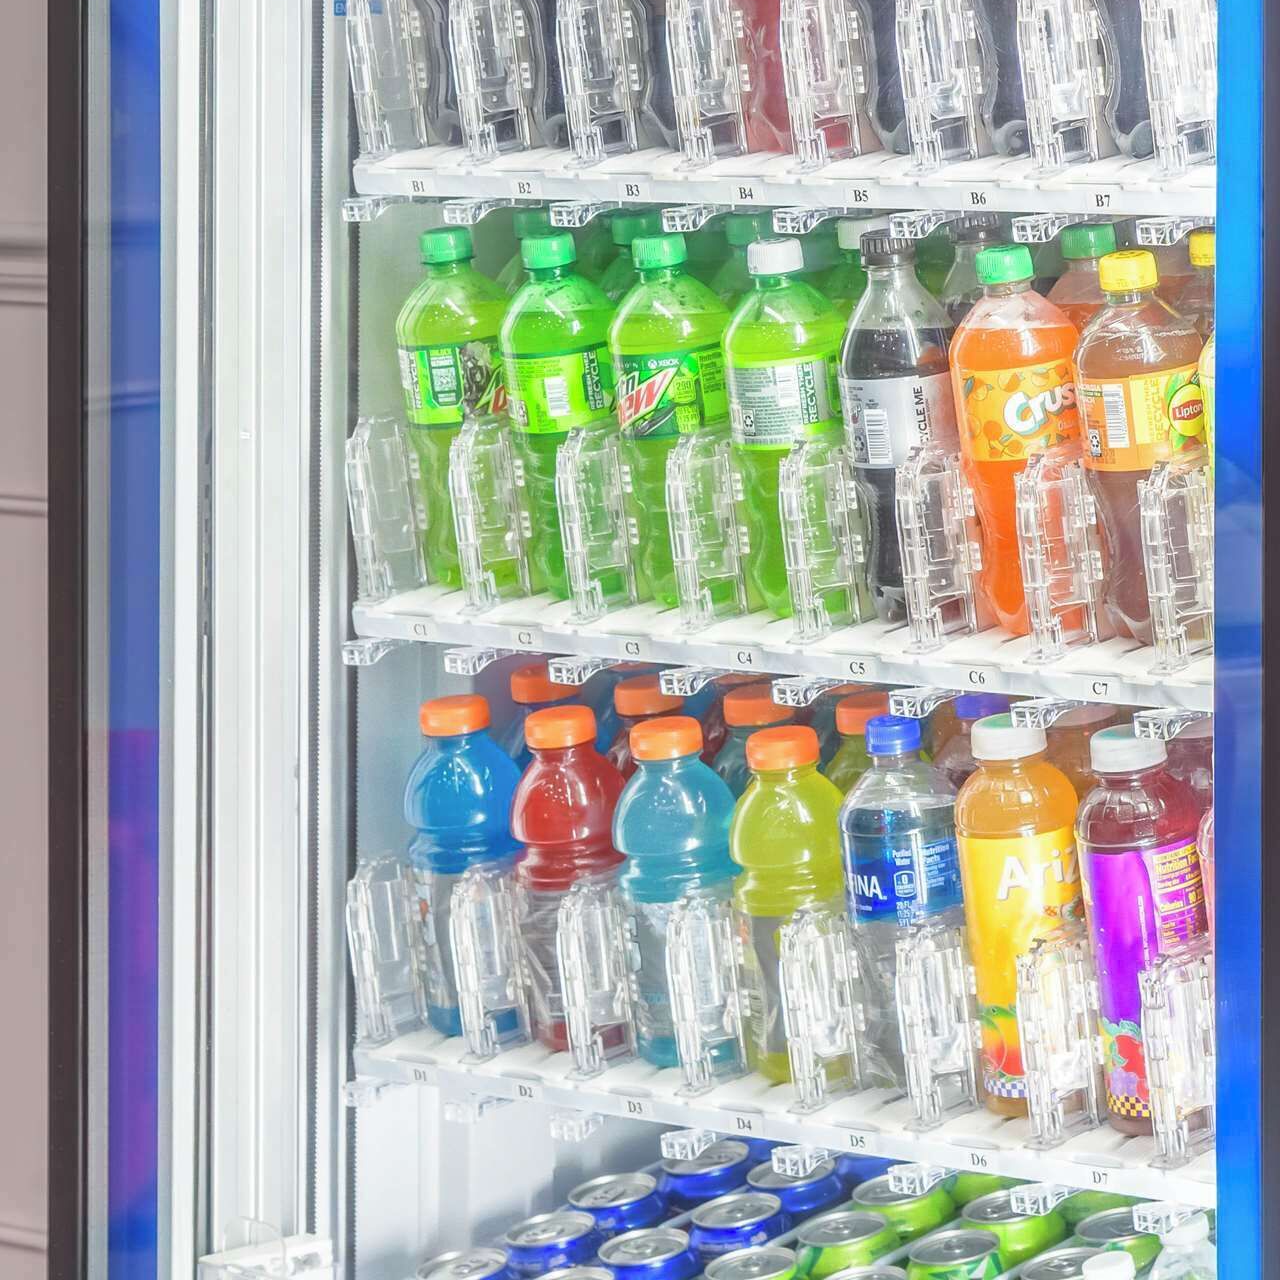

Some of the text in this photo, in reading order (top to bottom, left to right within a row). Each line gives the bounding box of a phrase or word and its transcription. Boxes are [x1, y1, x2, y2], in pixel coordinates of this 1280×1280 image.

[412, 180, 426, 193] B1
[625, 183, 640, 196] B3
[970, 192, 987, 205] B6
[657, 358, 680, 367] XBOX
[594, 350, 603, 410] RECYCLE
[809, 361, 820, 423] RECYCLE
[518, 632, 533, 645] C2
[849, 661, 865, 674] C5
[1092, 682, 1108, 696] C7
[628, 1100, 642, 1114] D3
[850, 1134, 866, 1148] D5
[970, 1153, 987, 1167] D6
